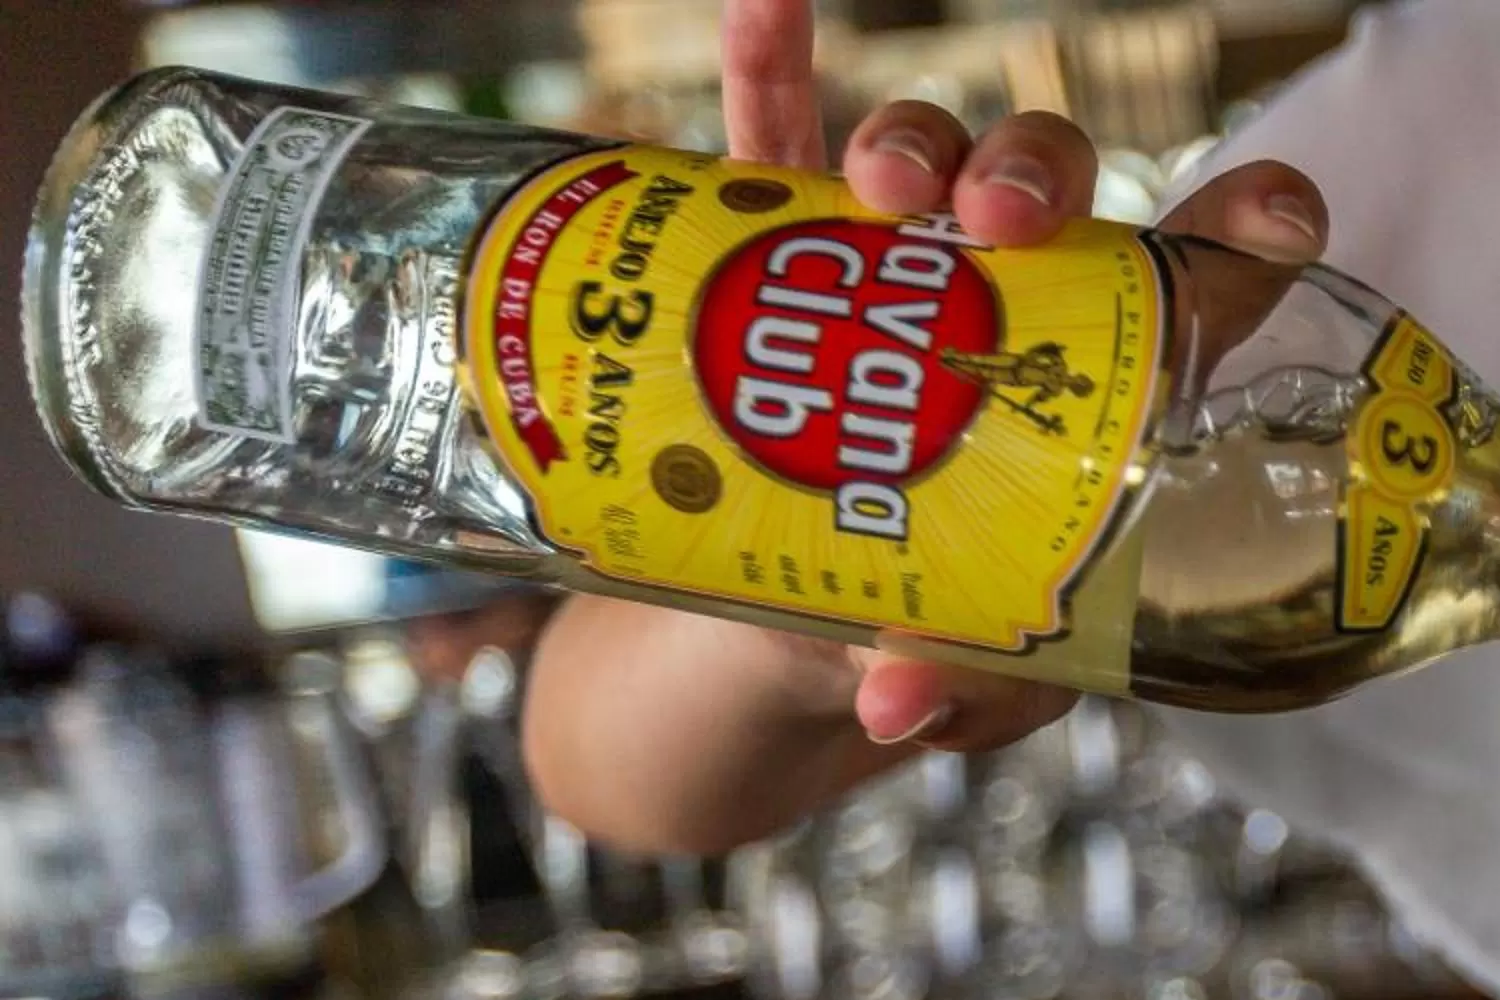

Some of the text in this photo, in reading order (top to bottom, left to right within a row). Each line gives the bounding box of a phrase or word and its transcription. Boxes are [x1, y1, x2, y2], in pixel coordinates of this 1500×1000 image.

[608, 174, 696, 282] AÑEJO
[499, 178, 600, 428] EL RON DE CUBA
[570, 280, 655, 347] 3
[732, 236, 866, 438] Club
[835, 213, 995, 541] Havana
[1049, 418, 1122, 553] CUBANO
[1381, 419, 1438, 475] 3
[1366, 515, 1400, 587] AÑOS
